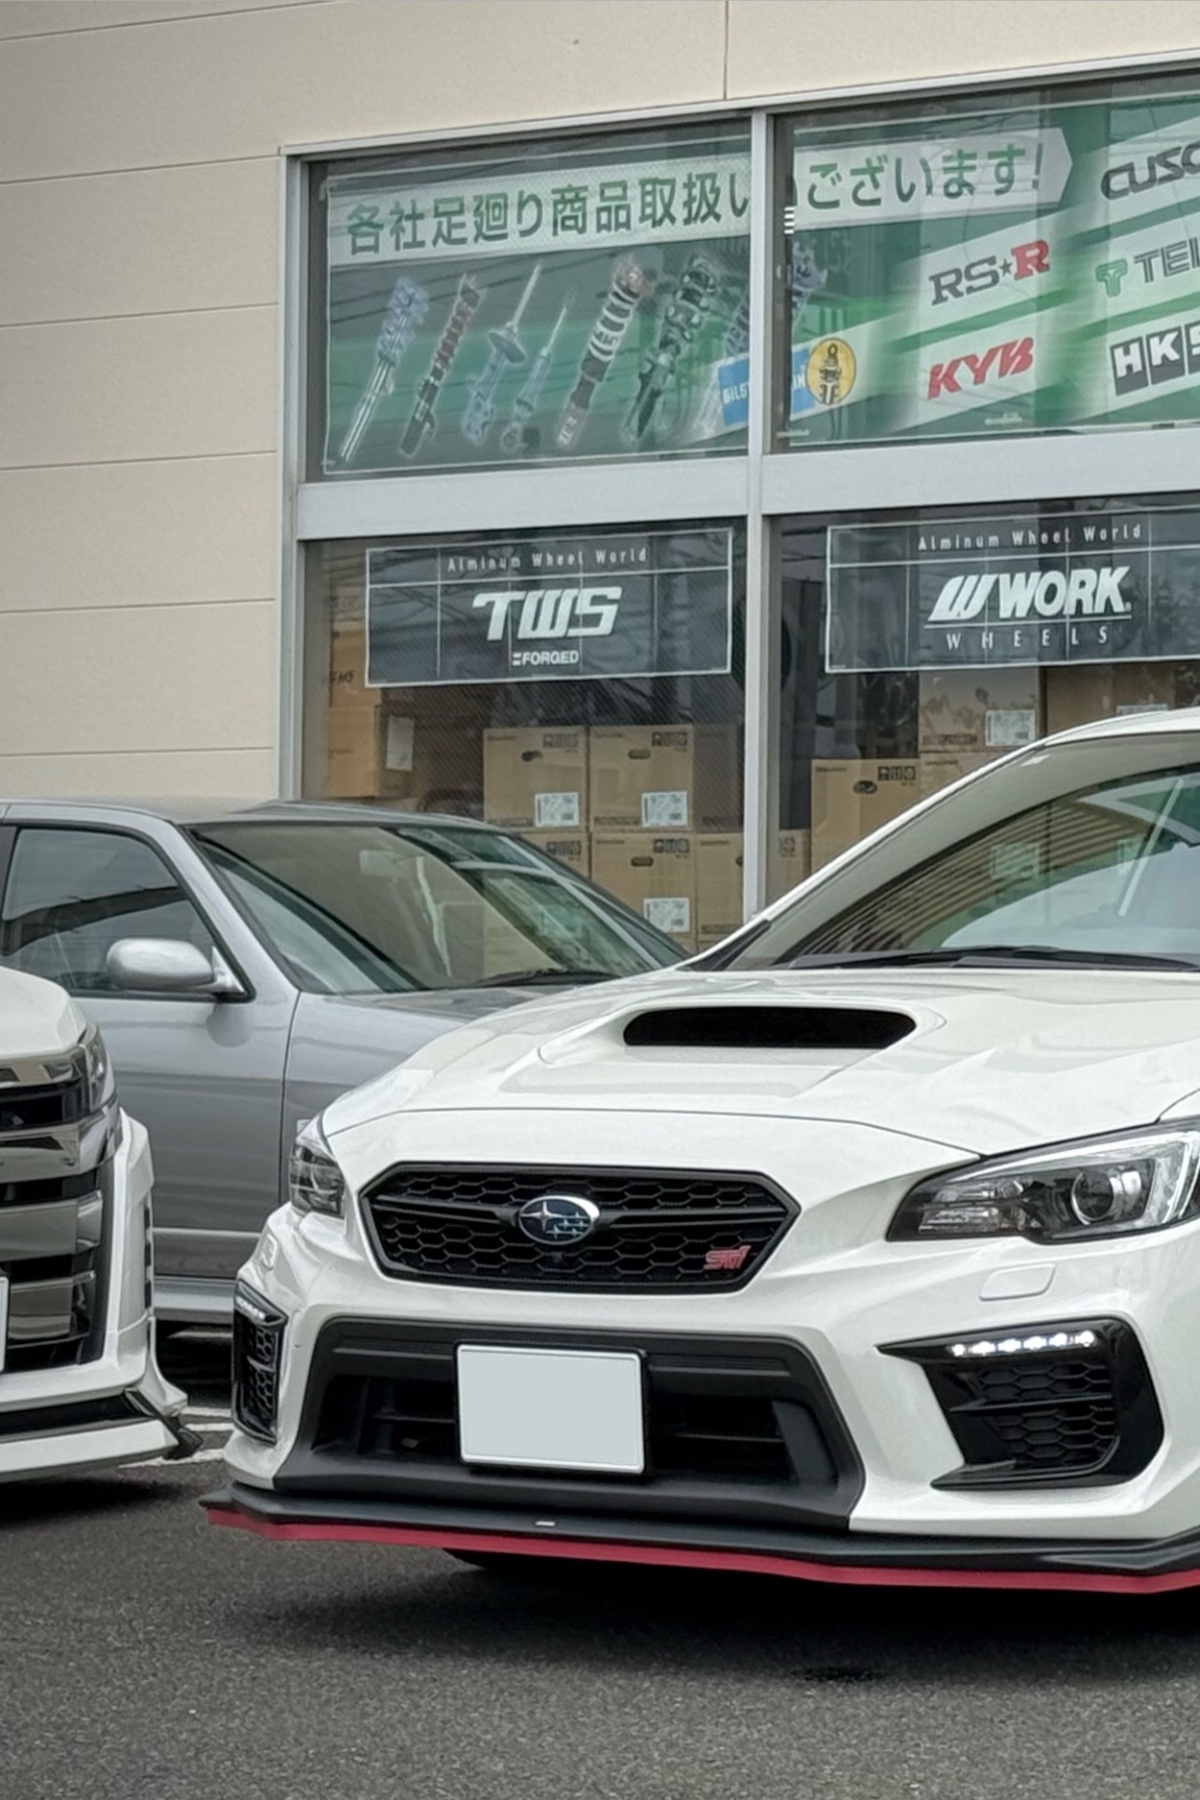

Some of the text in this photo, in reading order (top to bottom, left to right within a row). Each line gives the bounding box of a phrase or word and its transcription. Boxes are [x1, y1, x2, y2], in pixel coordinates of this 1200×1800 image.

[927, 336, 1034, 400] KYB
[917, 523, 1142, 551] Alminum Wheel World
[447, 547, 647, 572] Alminum Wheel World
[998, 566, 1131, 619] WORK
[472, 586, 622, 641] TWS
[946, 626, 1109, 651] WHEELS
